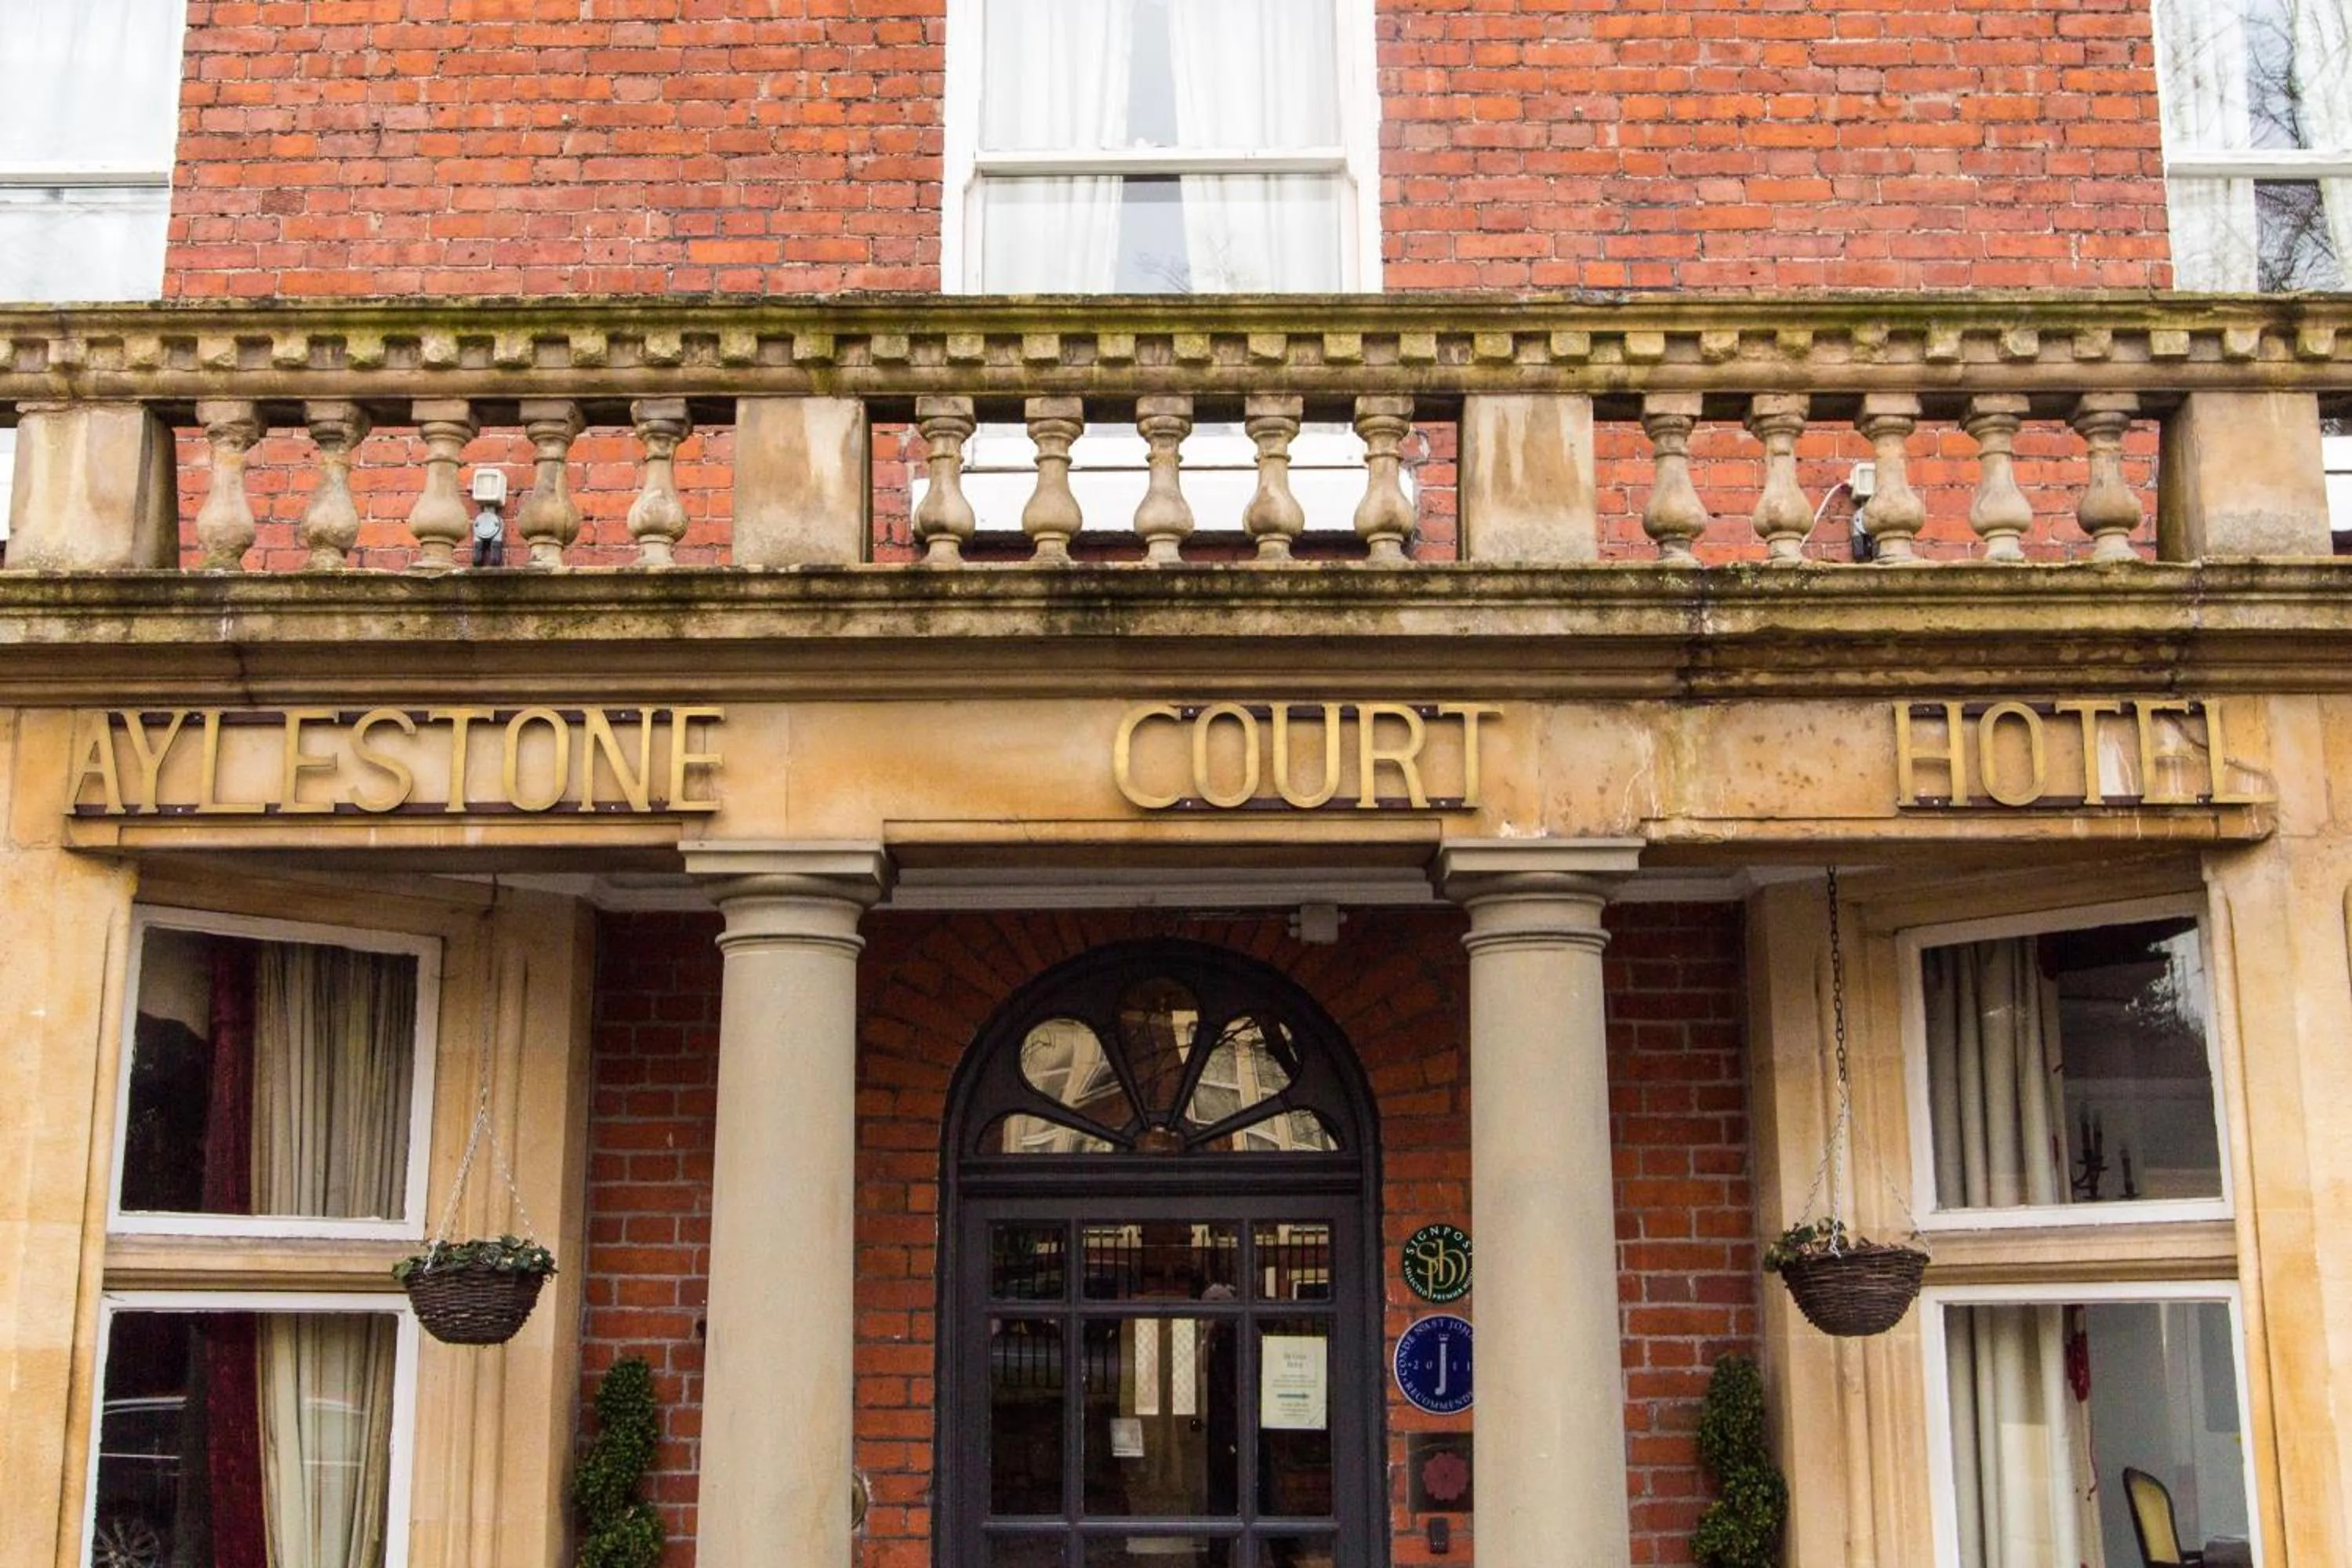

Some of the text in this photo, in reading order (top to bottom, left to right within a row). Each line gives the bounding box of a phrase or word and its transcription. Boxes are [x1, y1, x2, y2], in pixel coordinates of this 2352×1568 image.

[64, 700, 2277, 814] AYLESTONE COURT HOTEL
[1405, 1381, 1472, 1410] RECOMMEND
